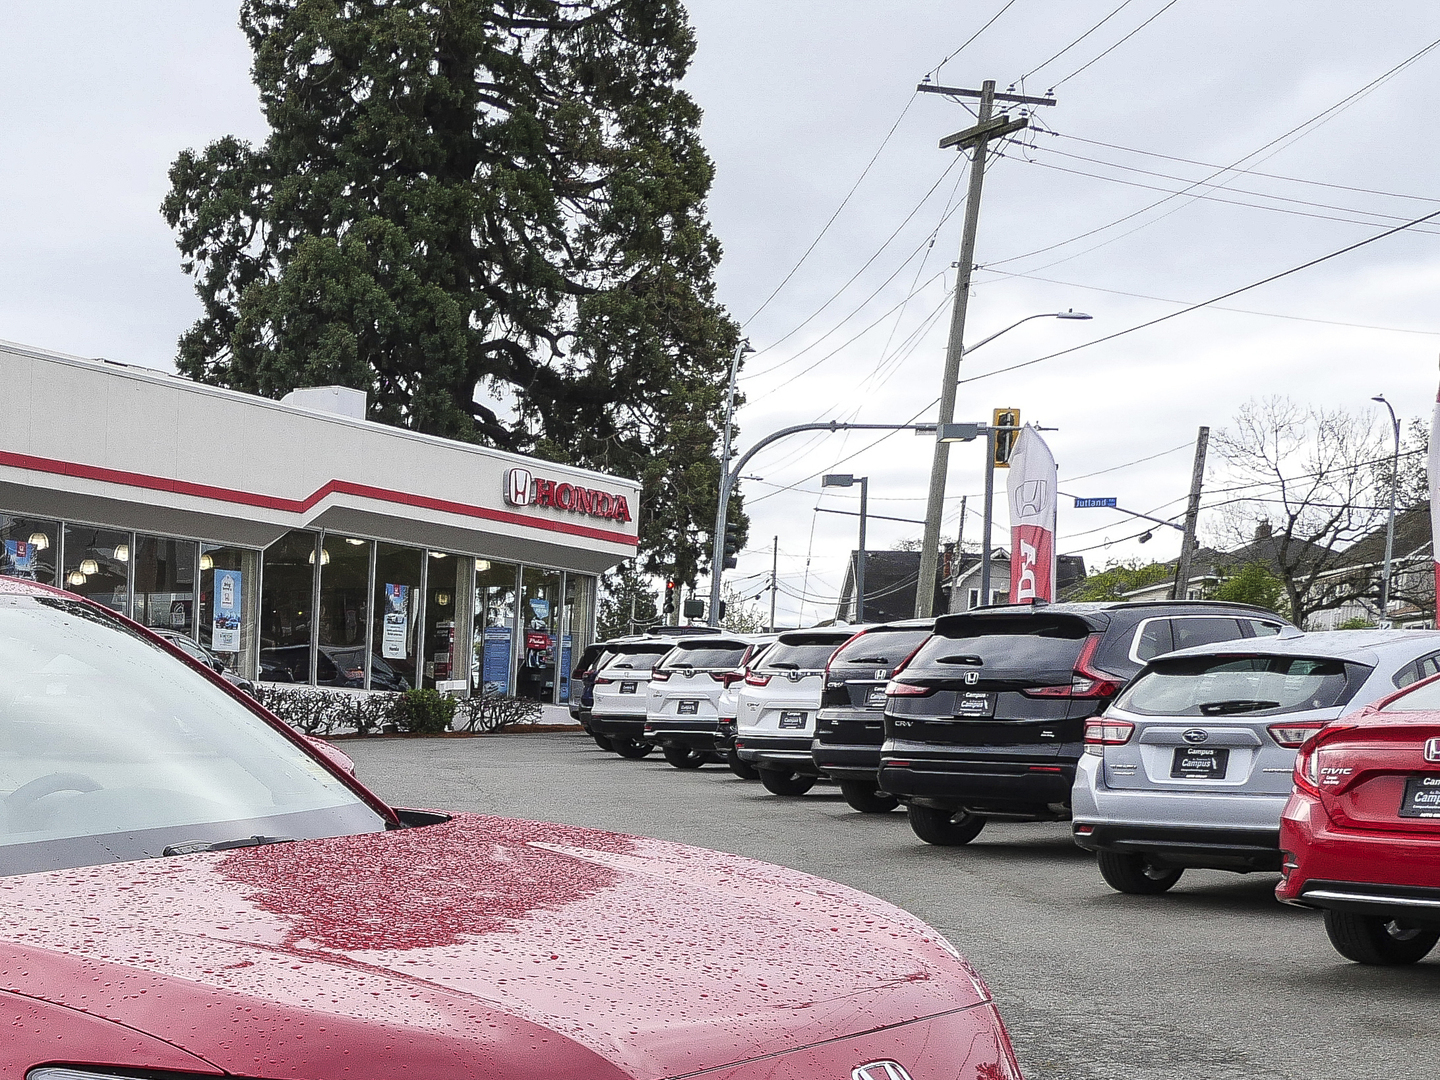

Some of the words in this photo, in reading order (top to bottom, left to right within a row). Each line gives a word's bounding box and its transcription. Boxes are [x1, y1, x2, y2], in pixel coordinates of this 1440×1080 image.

[534, 478, 632, 522] HONDA
[1076, 499, 1107, 507] Jutland
[1187, 748, 1214, 756] Campus
[1181, 758, 1211, 769] Campus
[1320, 767, 1353, 775] CIVIC
